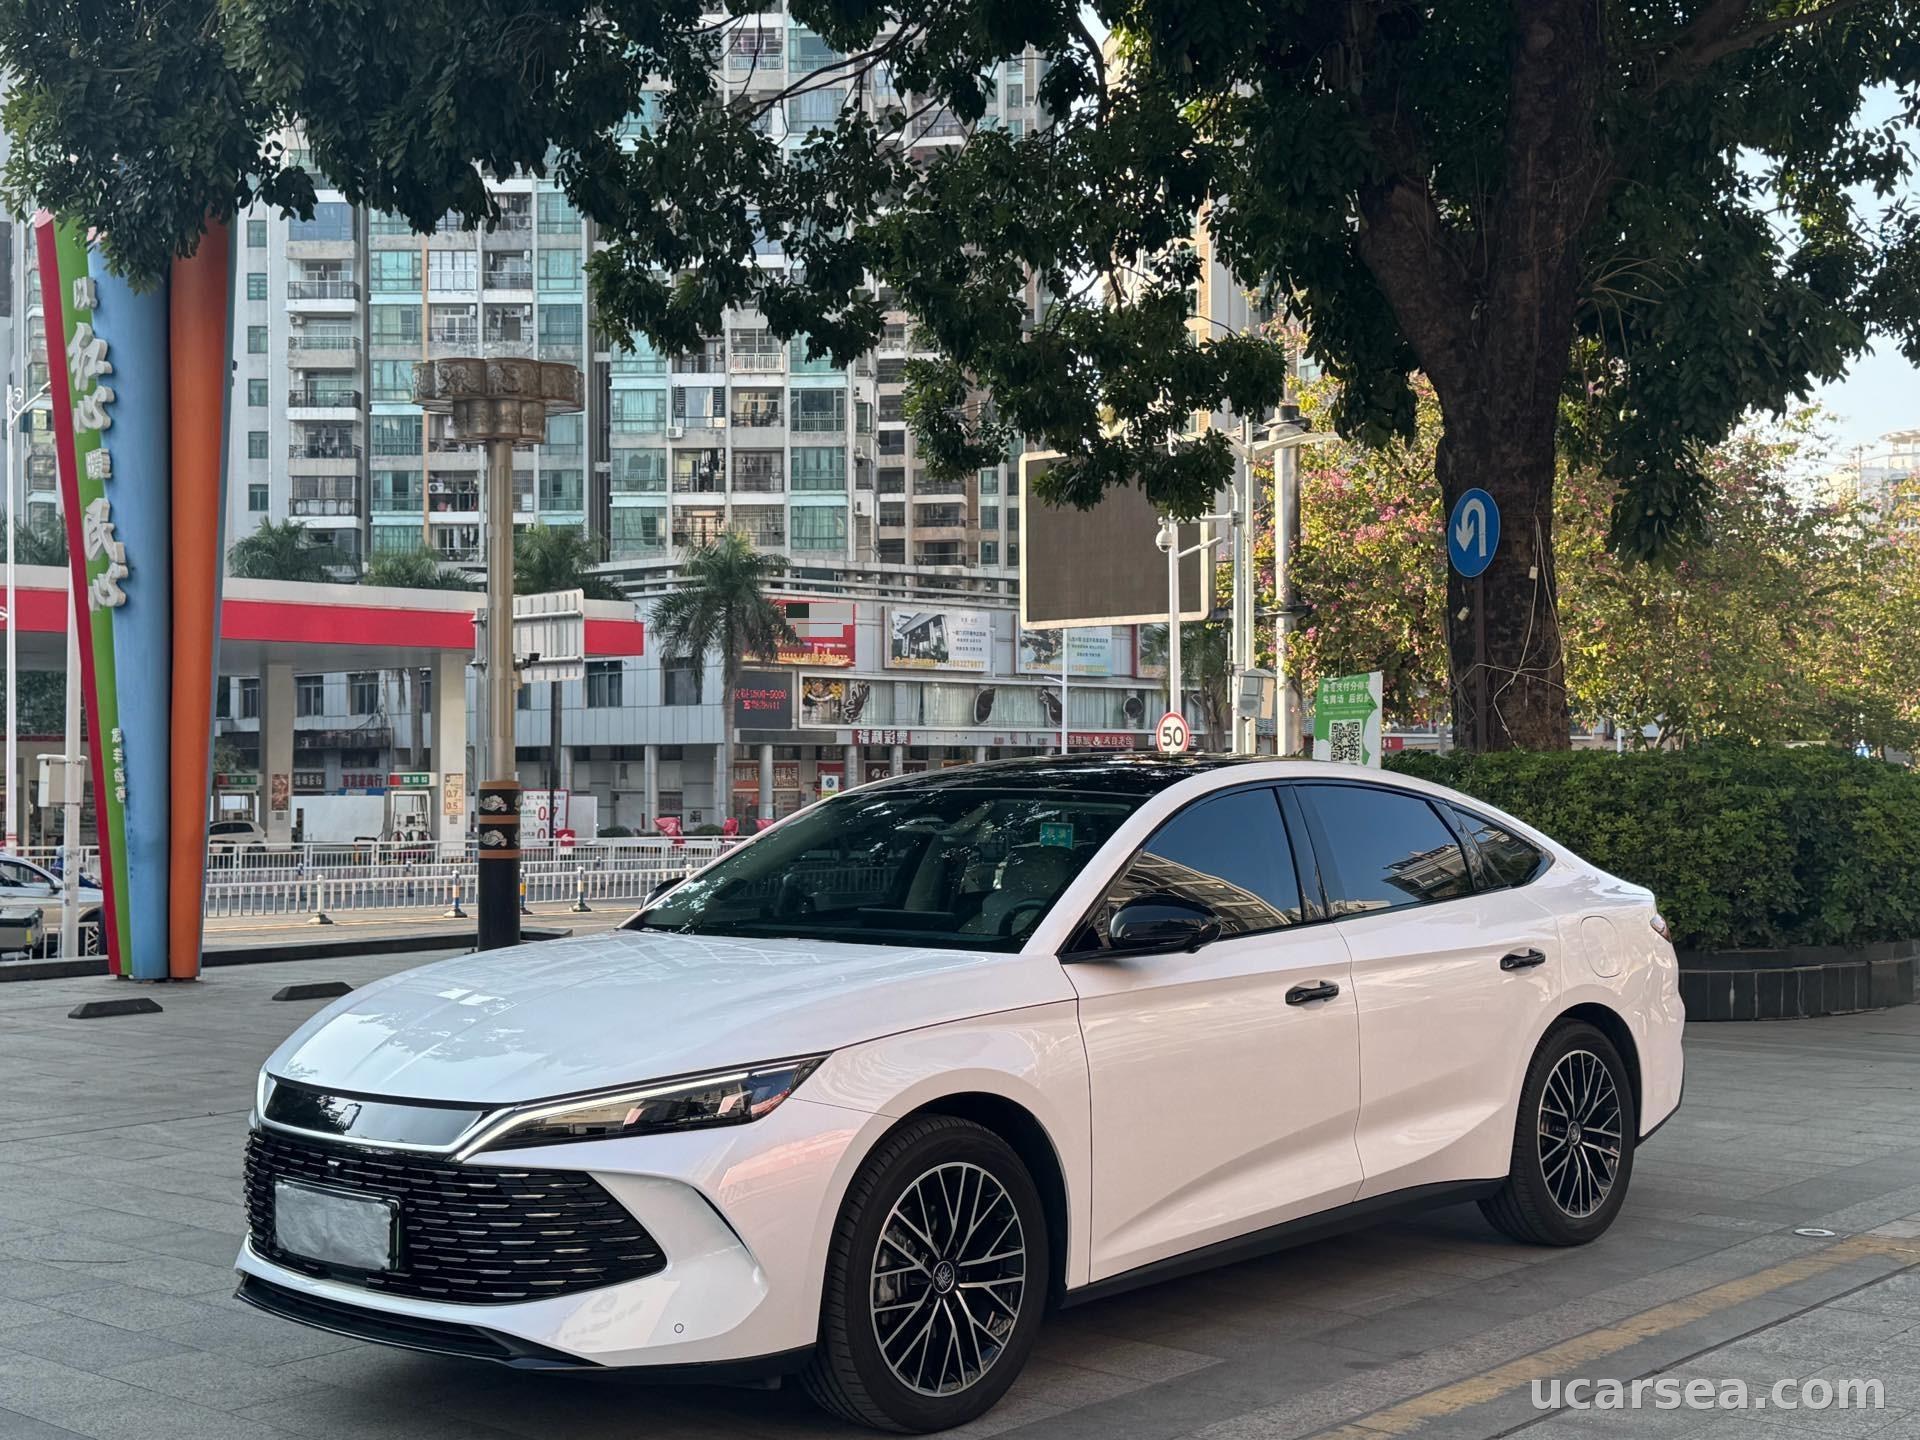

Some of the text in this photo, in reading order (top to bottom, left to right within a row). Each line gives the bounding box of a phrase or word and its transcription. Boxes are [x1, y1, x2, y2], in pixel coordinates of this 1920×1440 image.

[857, 729, 908, 745] 福利彩票
[1163, 726, 1184, 746] 50
